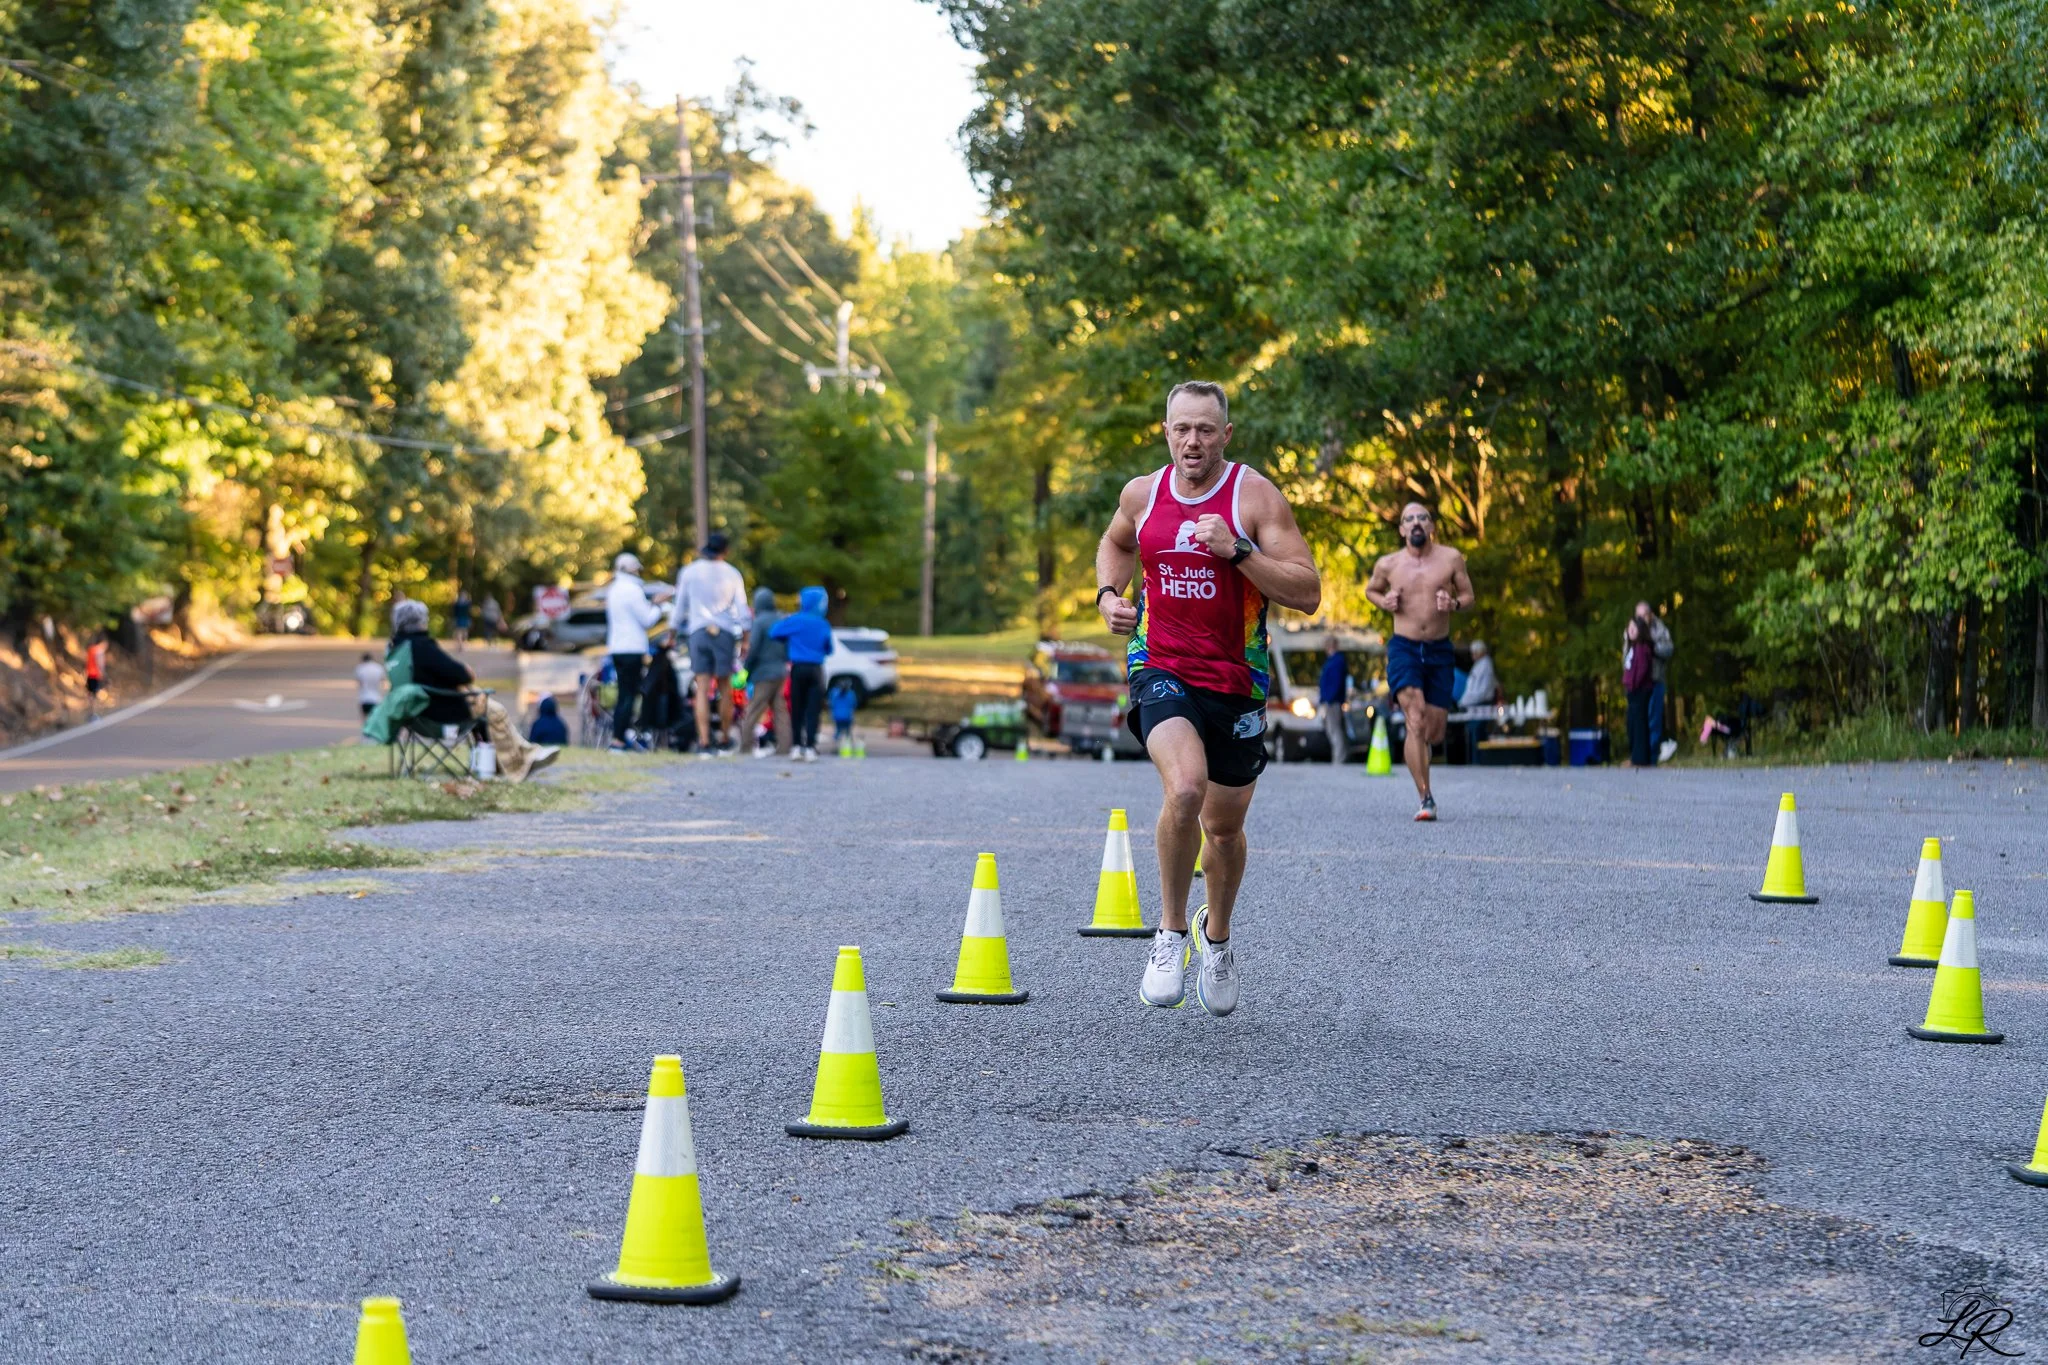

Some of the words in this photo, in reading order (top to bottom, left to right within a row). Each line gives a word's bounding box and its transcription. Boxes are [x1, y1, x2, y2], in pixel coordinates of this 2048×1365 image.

[1158, 563, 1178, 577] St.
[1180, 566, 1215, 579] Jude
[1160, 577, 1217, 599] HERO
